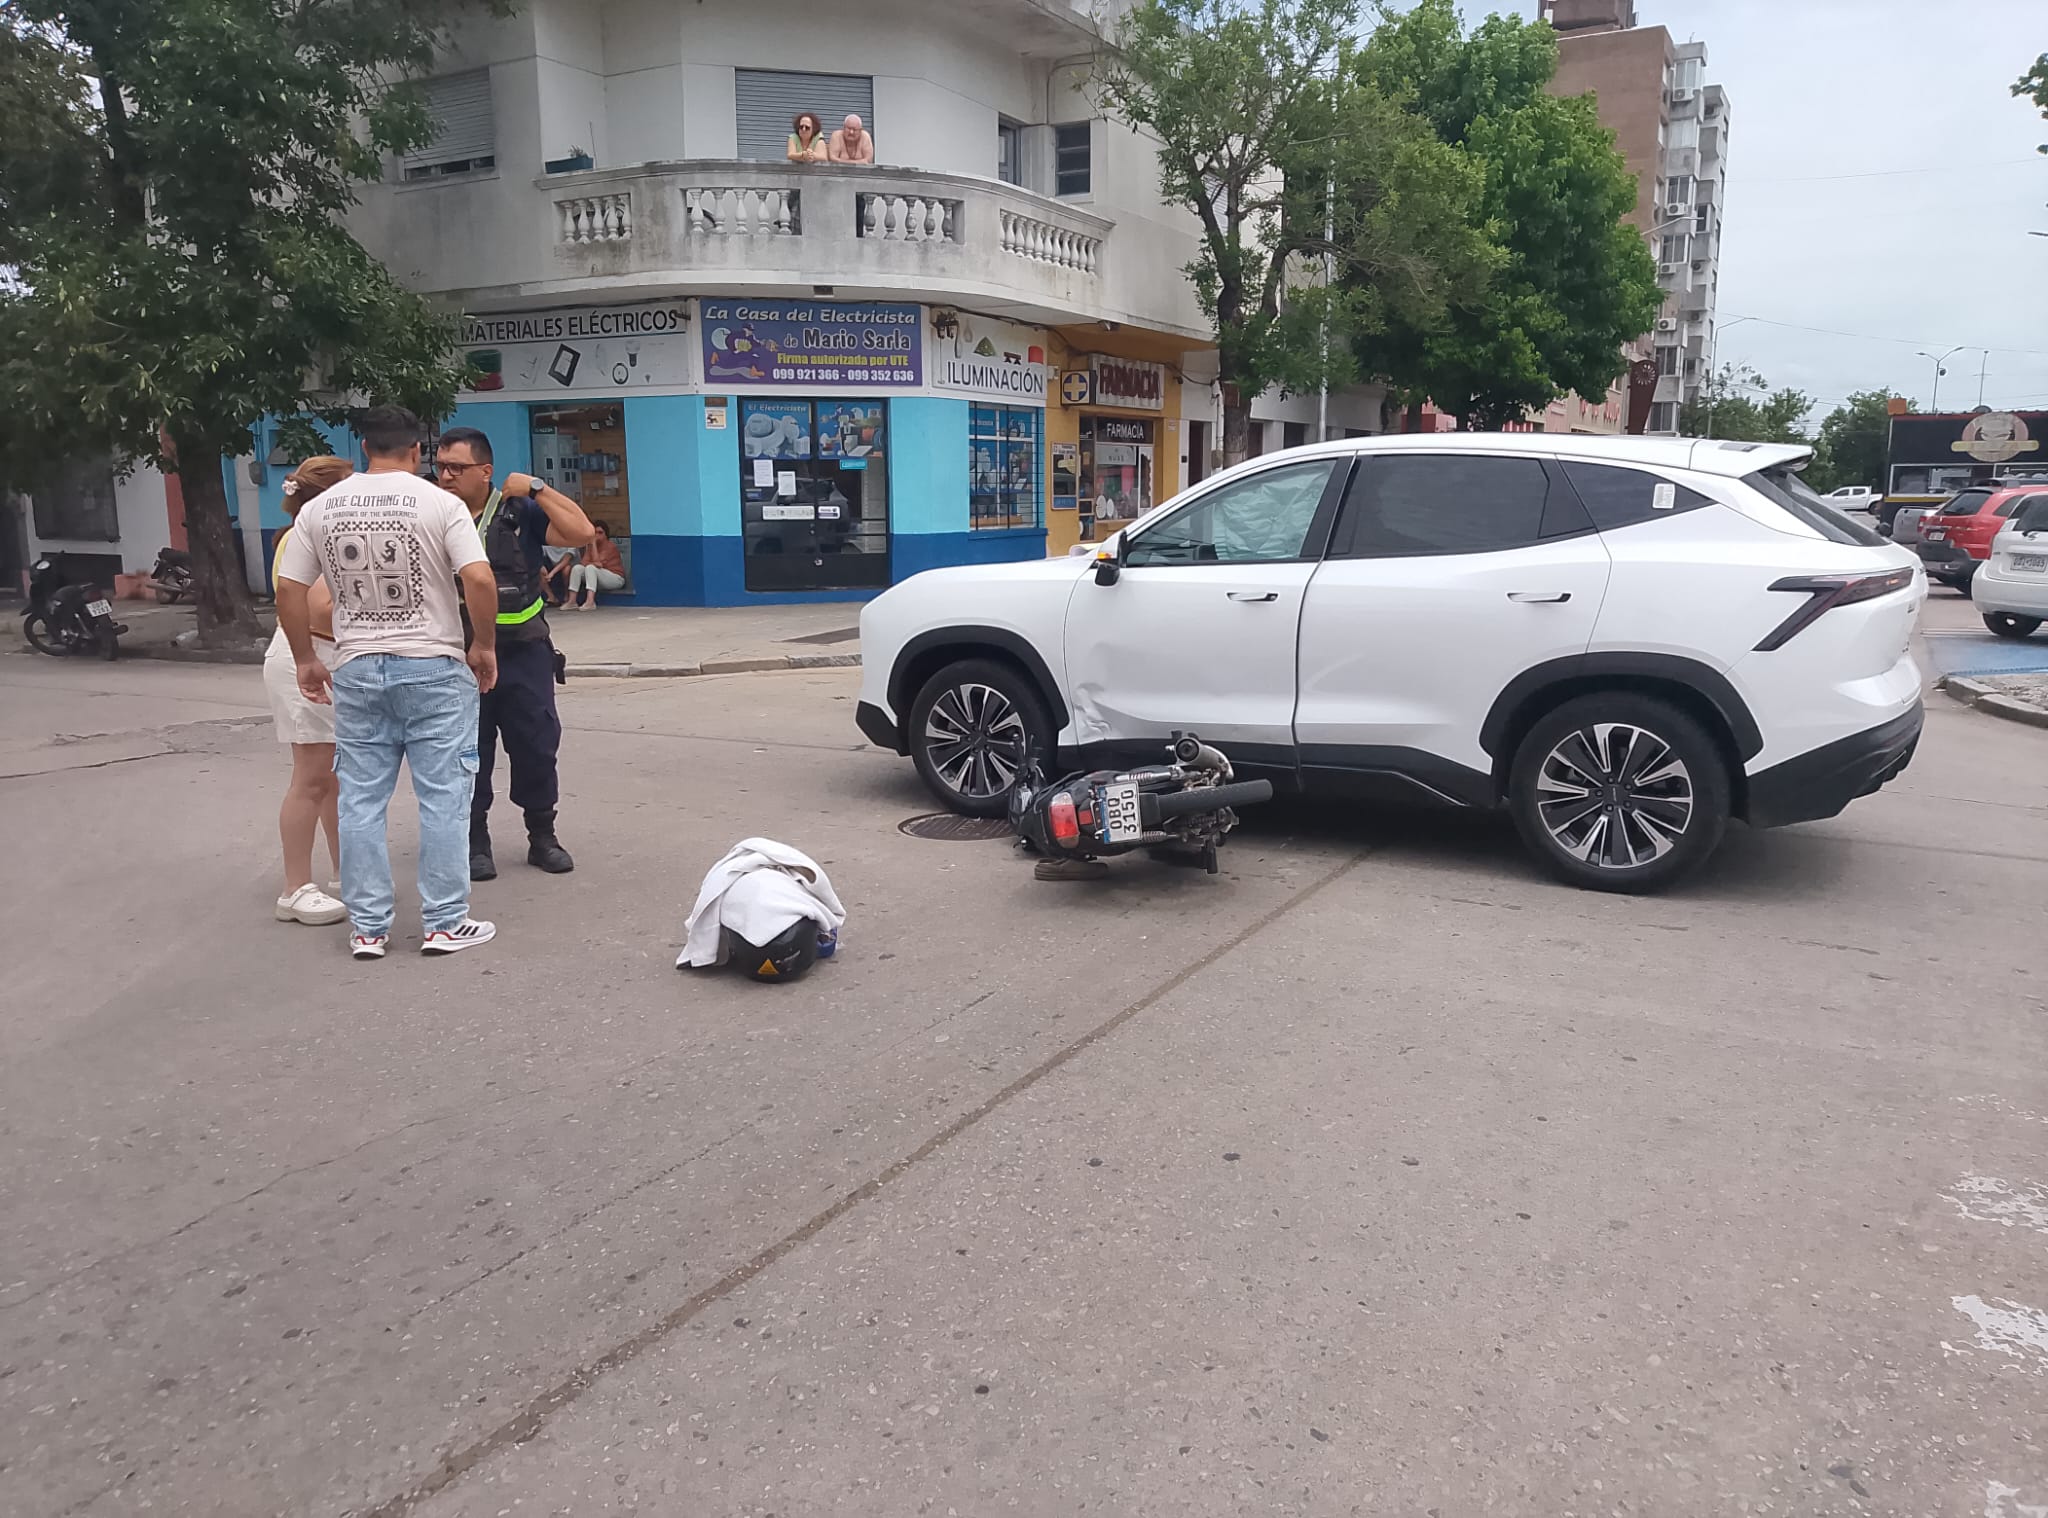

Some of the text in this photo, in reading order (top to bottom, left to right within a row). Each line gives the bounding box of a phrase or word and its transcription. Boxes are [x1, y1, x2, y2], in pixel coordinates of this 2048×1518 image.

[705, 306, 915, 324] La Casa del Electricista
[460, 310, 677, 342] MATERIALES ELÉCTRICOS
[783, 333, 799, 349] de
[803, 327, 858, 350] Mario
[777, 353, 909, 367] Firma autorizada por UTE
[772, 368, 795, 380] 099
[797, 368, 816, 380] 921
[818, 369, 839, 380] 366
[848, 369, 869, 381] 099
[871, 370, 891, 381] 352
[893, 370, 914, 381] 636
[947, 361, 1043, 393] ILUMINACIÓN
[1106, 423, 1144, 439] FARMACIA
[325, 494, 418, 511] DIXIE CLOTHING CO.
[1120, 789, 1137, 834] 3150
